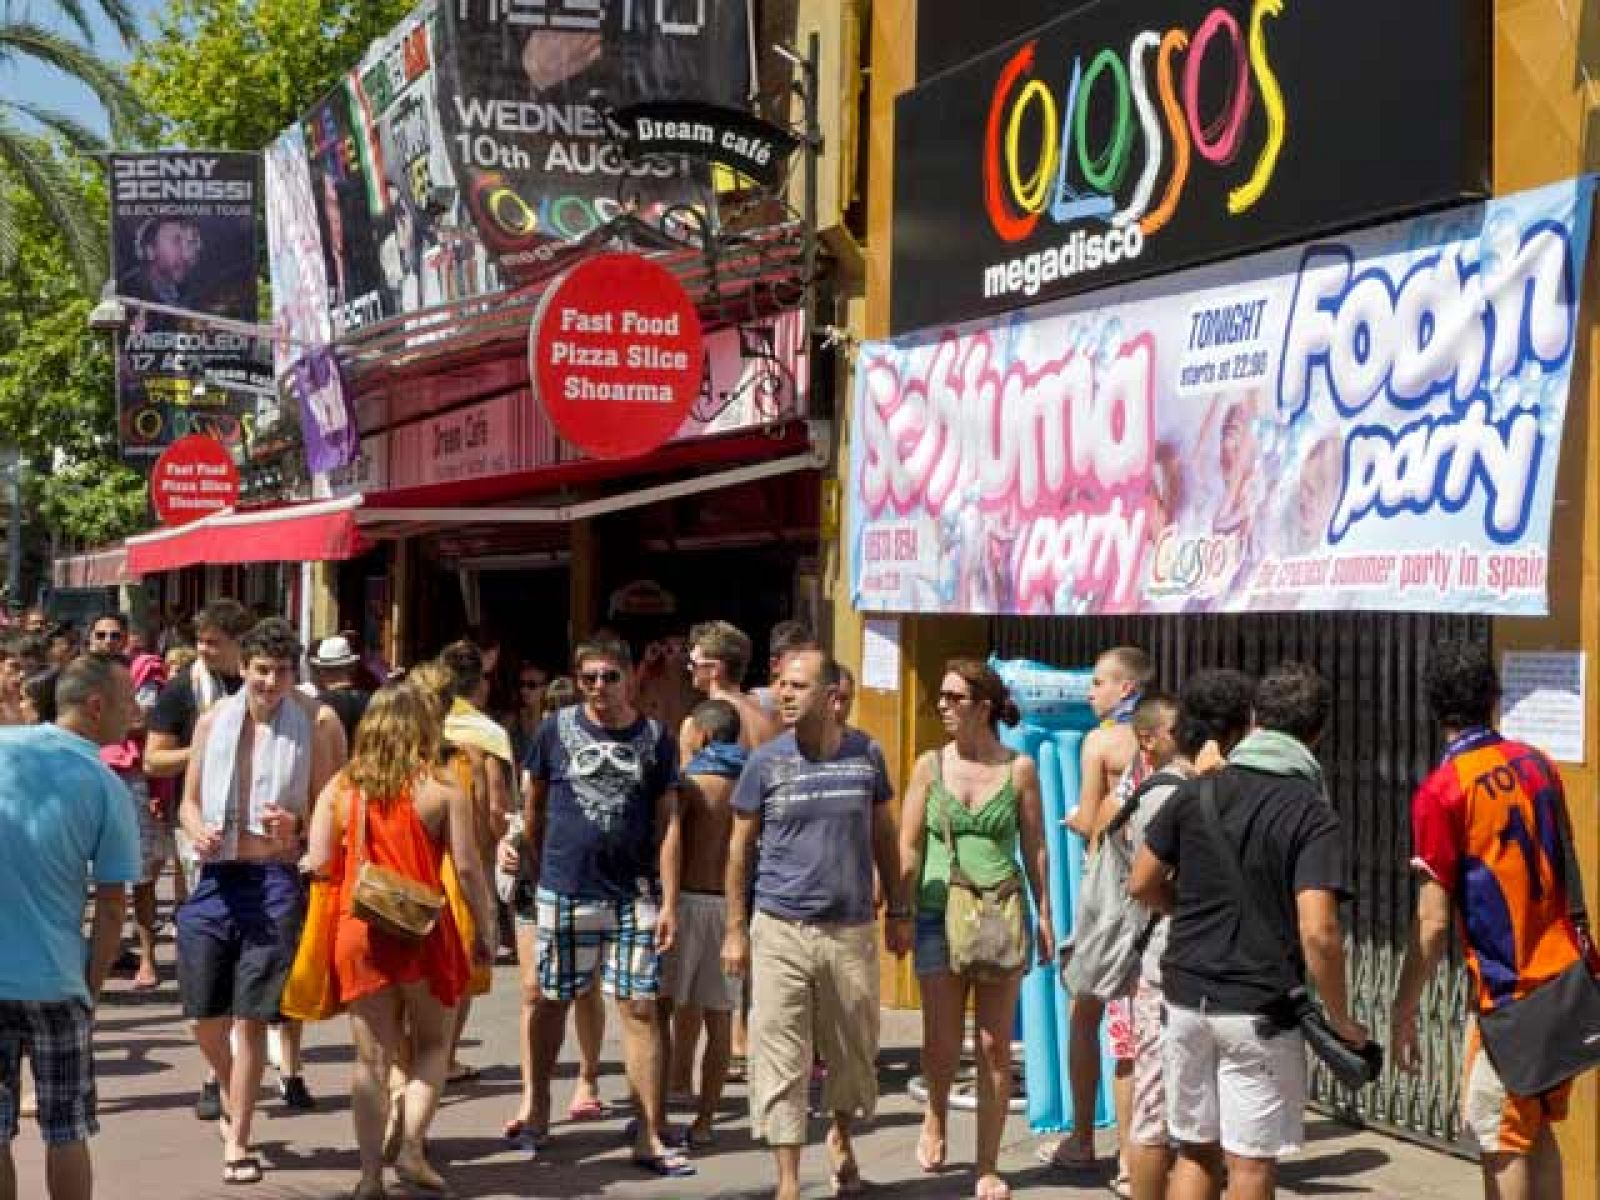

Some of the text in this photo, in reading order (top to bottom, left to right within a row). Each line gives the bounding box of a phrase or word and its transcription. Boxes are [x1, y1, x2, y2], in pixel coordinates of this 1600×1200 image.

[636, 117, 771, 165] Dream café
[982, 0, 1285, 242] COLOSSOS
[455, 133, 530, 169] 10th
[983, 223, 1143, 299] megadisco
[561, 308, 680, 336] Fast Food
[1188, 299, 1268, 350] TONIGHT
[1278, 220, 1572, 428] Foam
[551, 342, 689, 370] Pizza Slice
[563, 378, 674, 401] Shoarma
[1328, 404, 1541, 545] party
[1399, 547, 1451, 592] party
[1459, 547, 1479, 586] in
